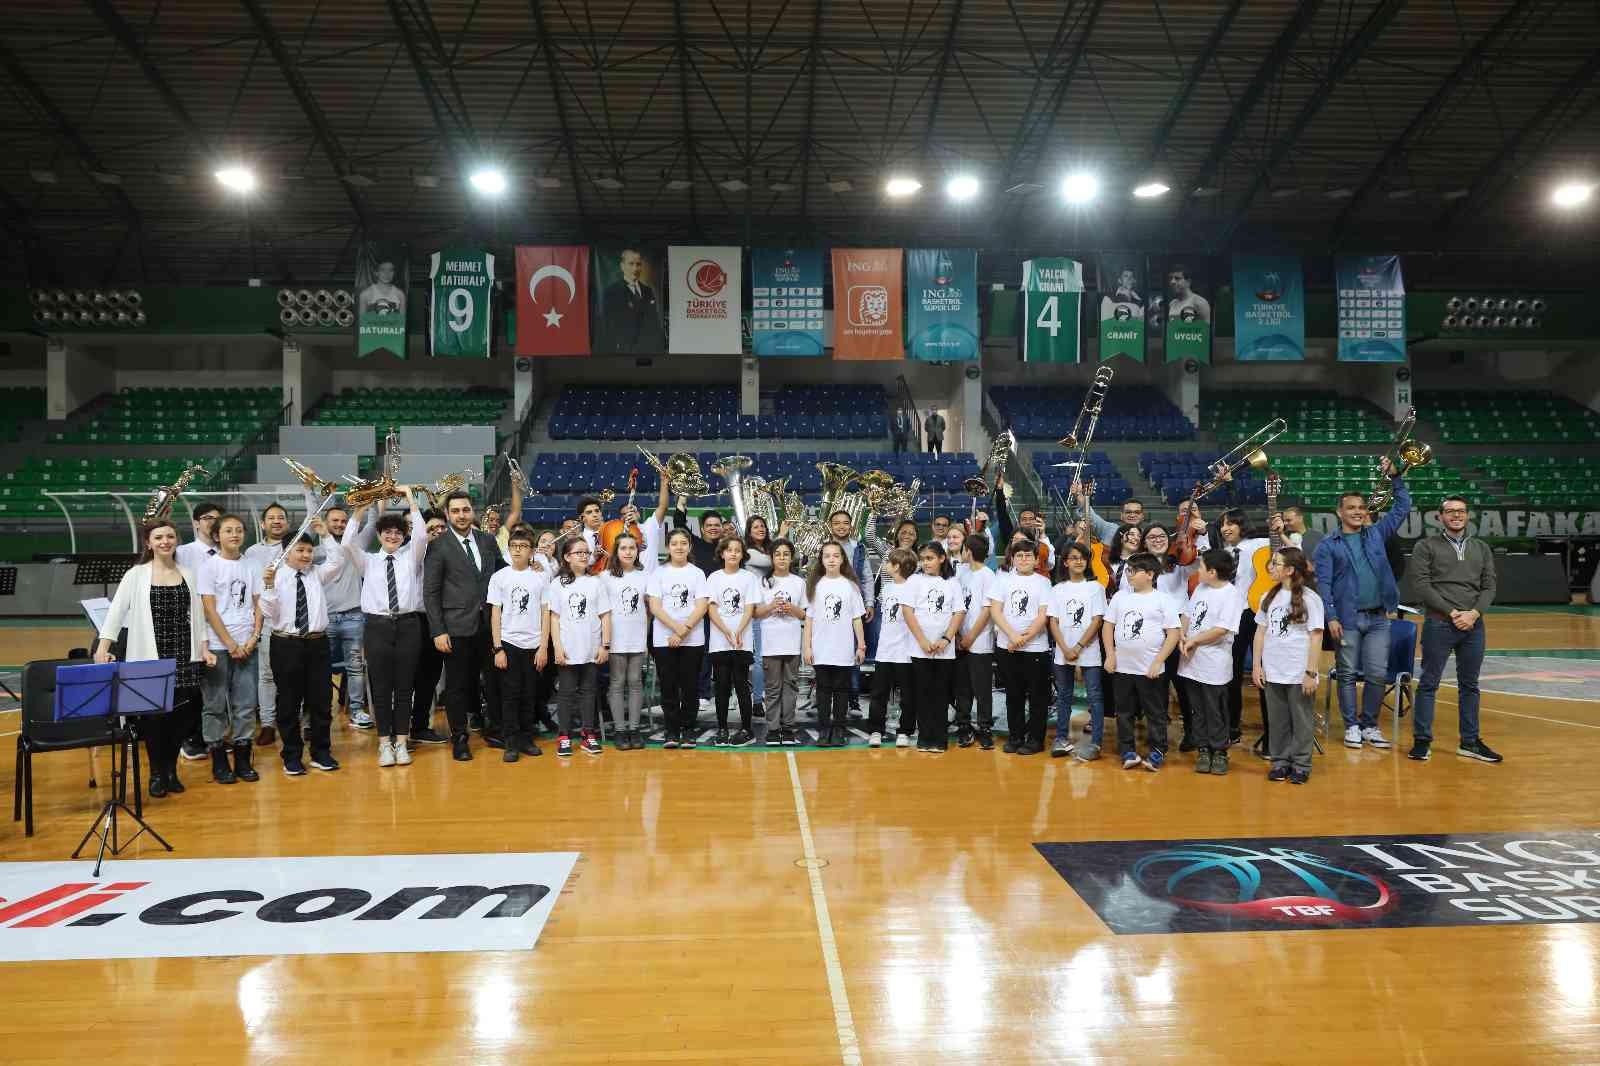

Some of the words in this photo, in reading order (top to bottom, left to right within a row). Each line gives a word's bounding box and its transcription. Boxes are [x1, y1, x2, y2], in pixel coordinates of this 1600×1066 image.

[445, 261, 483, 272] MEHMET
[441, 275, 486, 287] BATURALP
[922, 289, 946, 298] ING
[448, 288, 474, 332] 9
[1036, 296, 1062, 337] 4
[359, 326, 406, 336] BATURALP
[1343, 840, 1600, 870] ING
[1271, 904, 1336, 918] TBF
